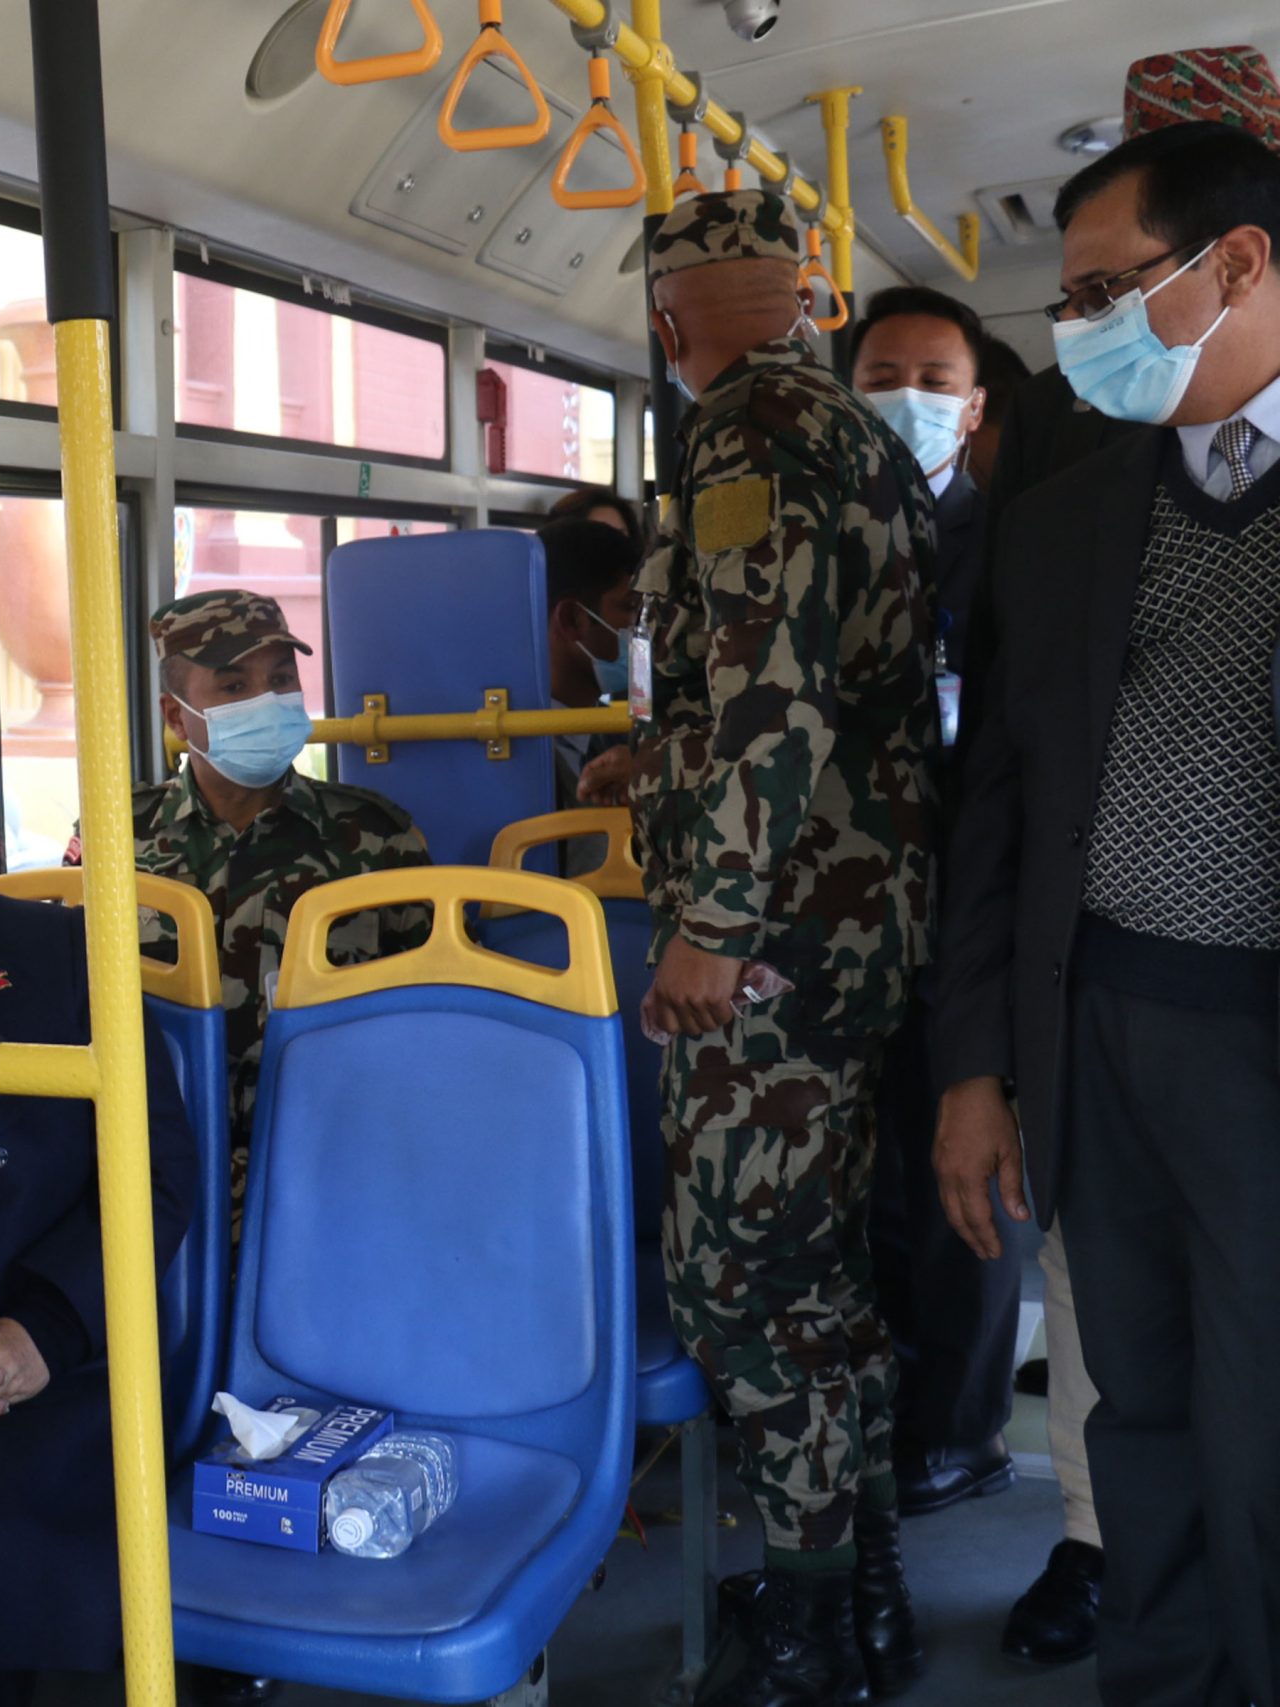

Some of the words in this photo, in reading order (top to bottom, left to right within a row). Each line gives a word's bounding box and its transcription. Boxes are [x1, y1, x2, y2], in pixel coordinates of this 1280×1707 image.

[293, 1406, 377, 1463] PREMIUM
[226, 1480, 288, 1502] PREMIUM
[213, 1508, 232, 1521] 100
